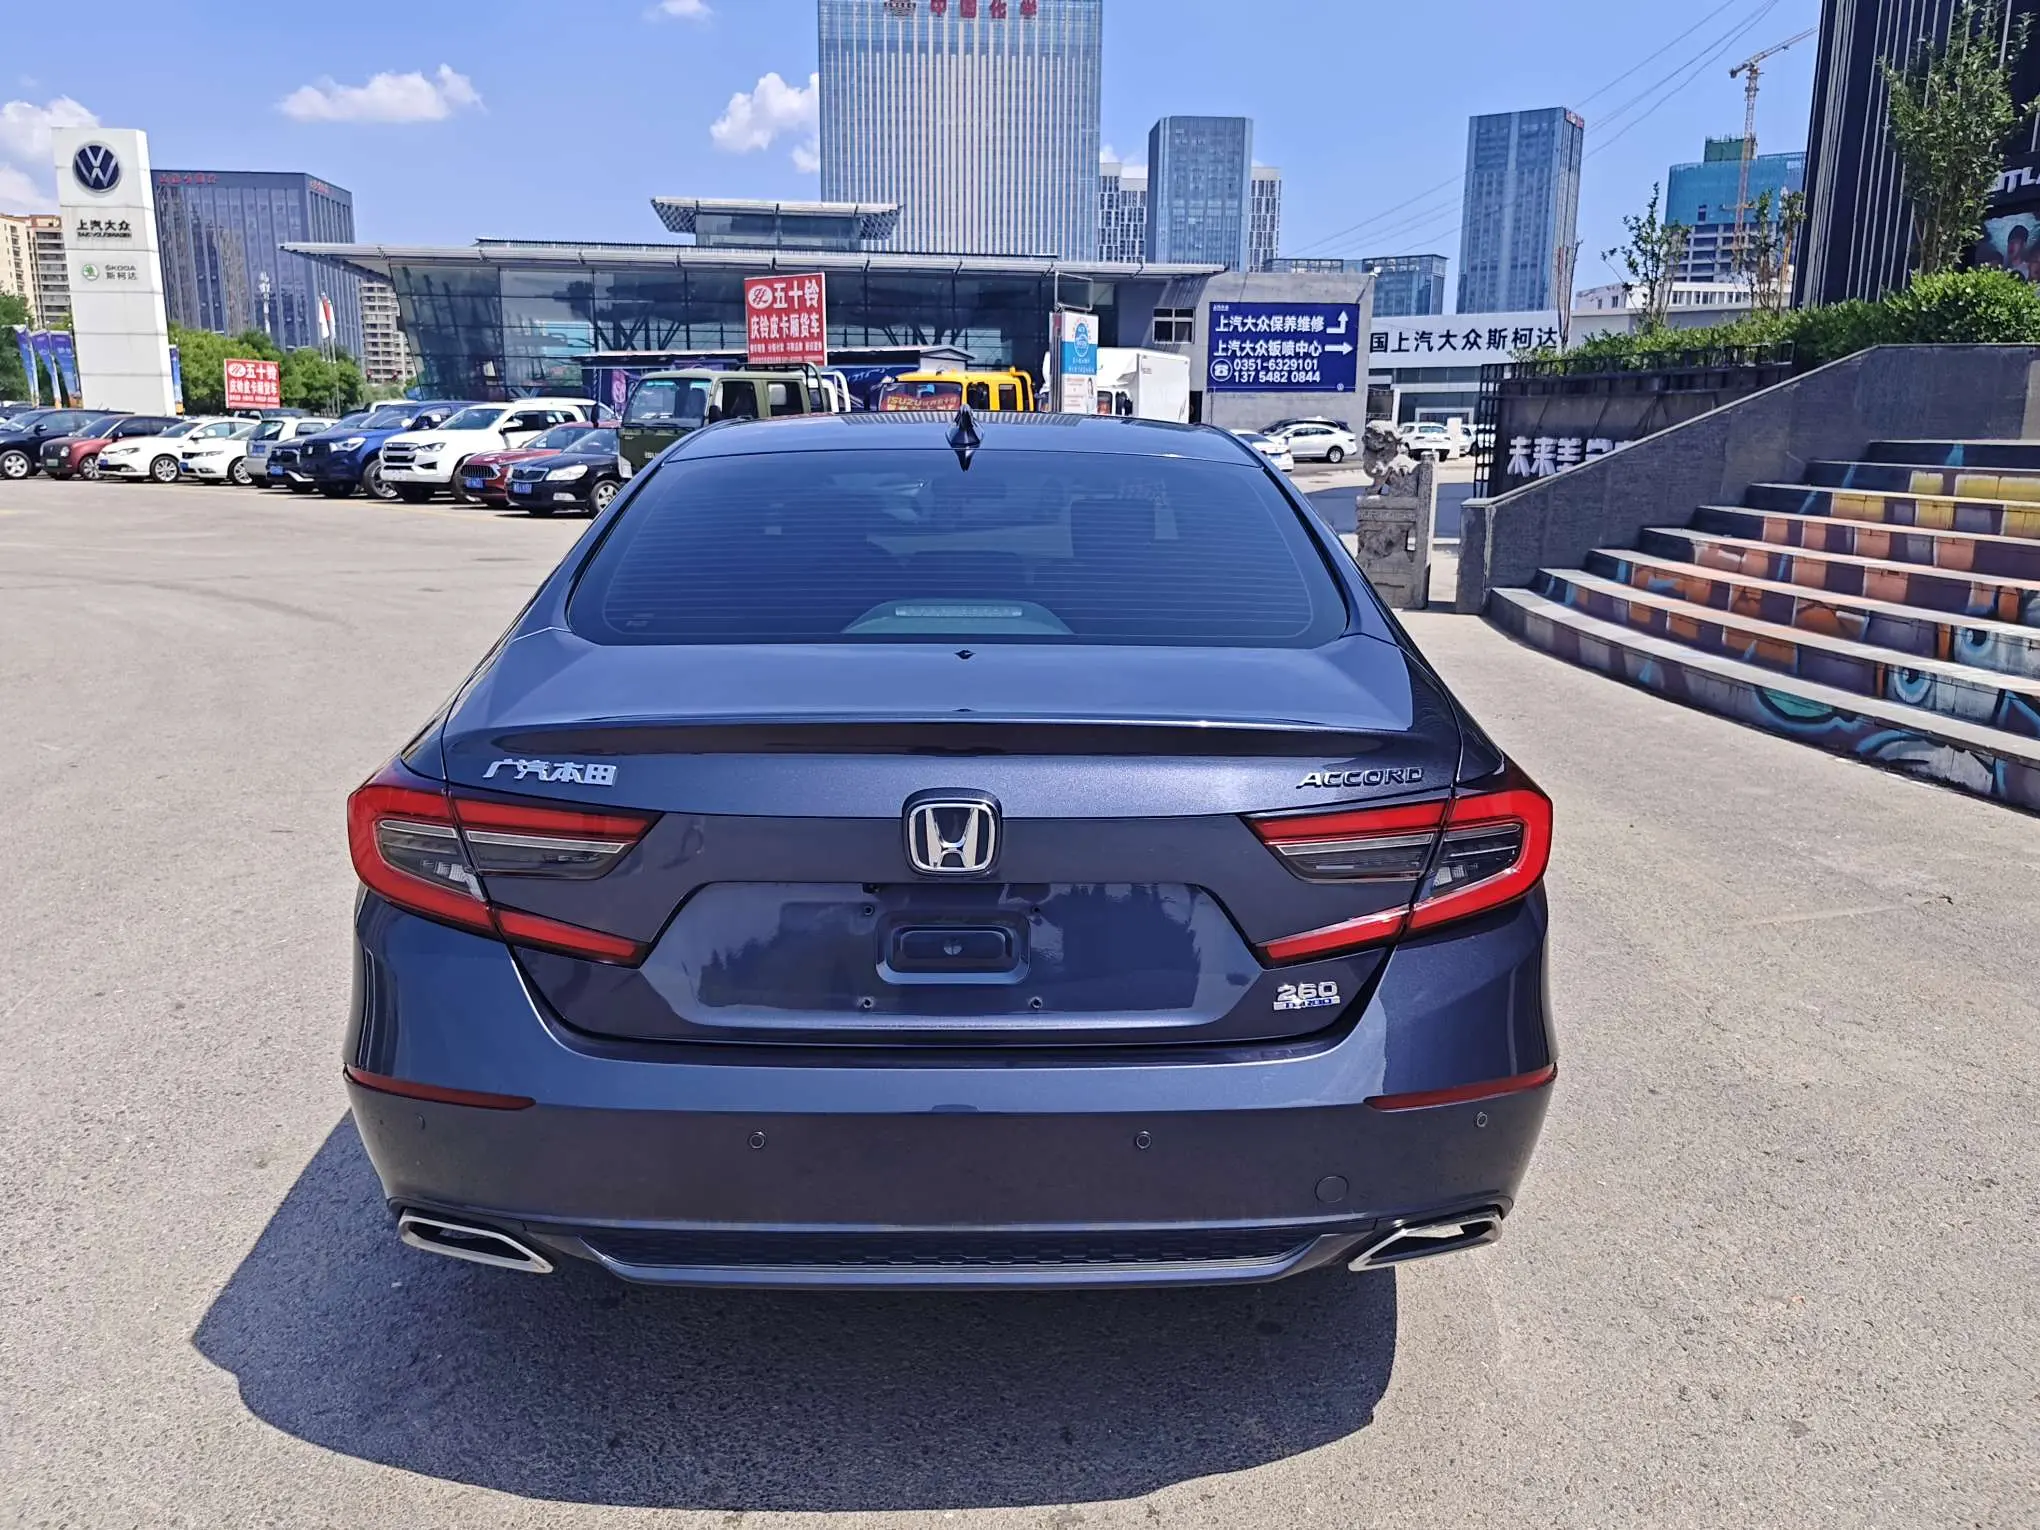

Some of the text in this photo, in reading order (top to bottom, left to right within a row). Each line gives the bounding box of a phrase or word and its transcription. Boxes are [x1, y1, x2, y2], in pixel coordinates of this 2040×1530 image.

[77, 219, 131, 231] 上汽大众
[773, 279, 819, 309] 五十铃
[1215, 315, 1325, 333] 上汽大众保养维修
[1213, 340, 1322, 357] 上汽大众钣喷中心
[1369, 327, 1558, 354] 国上汽大众斯柯达
[1233, 358, 1318, 371] 0351-6329101
[1234, 371, 1321, 384] 137 5482 0844
[482, 758, 617, 786] 广汽本田
[1296, 767, 1424, 789] ACCORD
[1277, 981, 1338, 1002] 260
